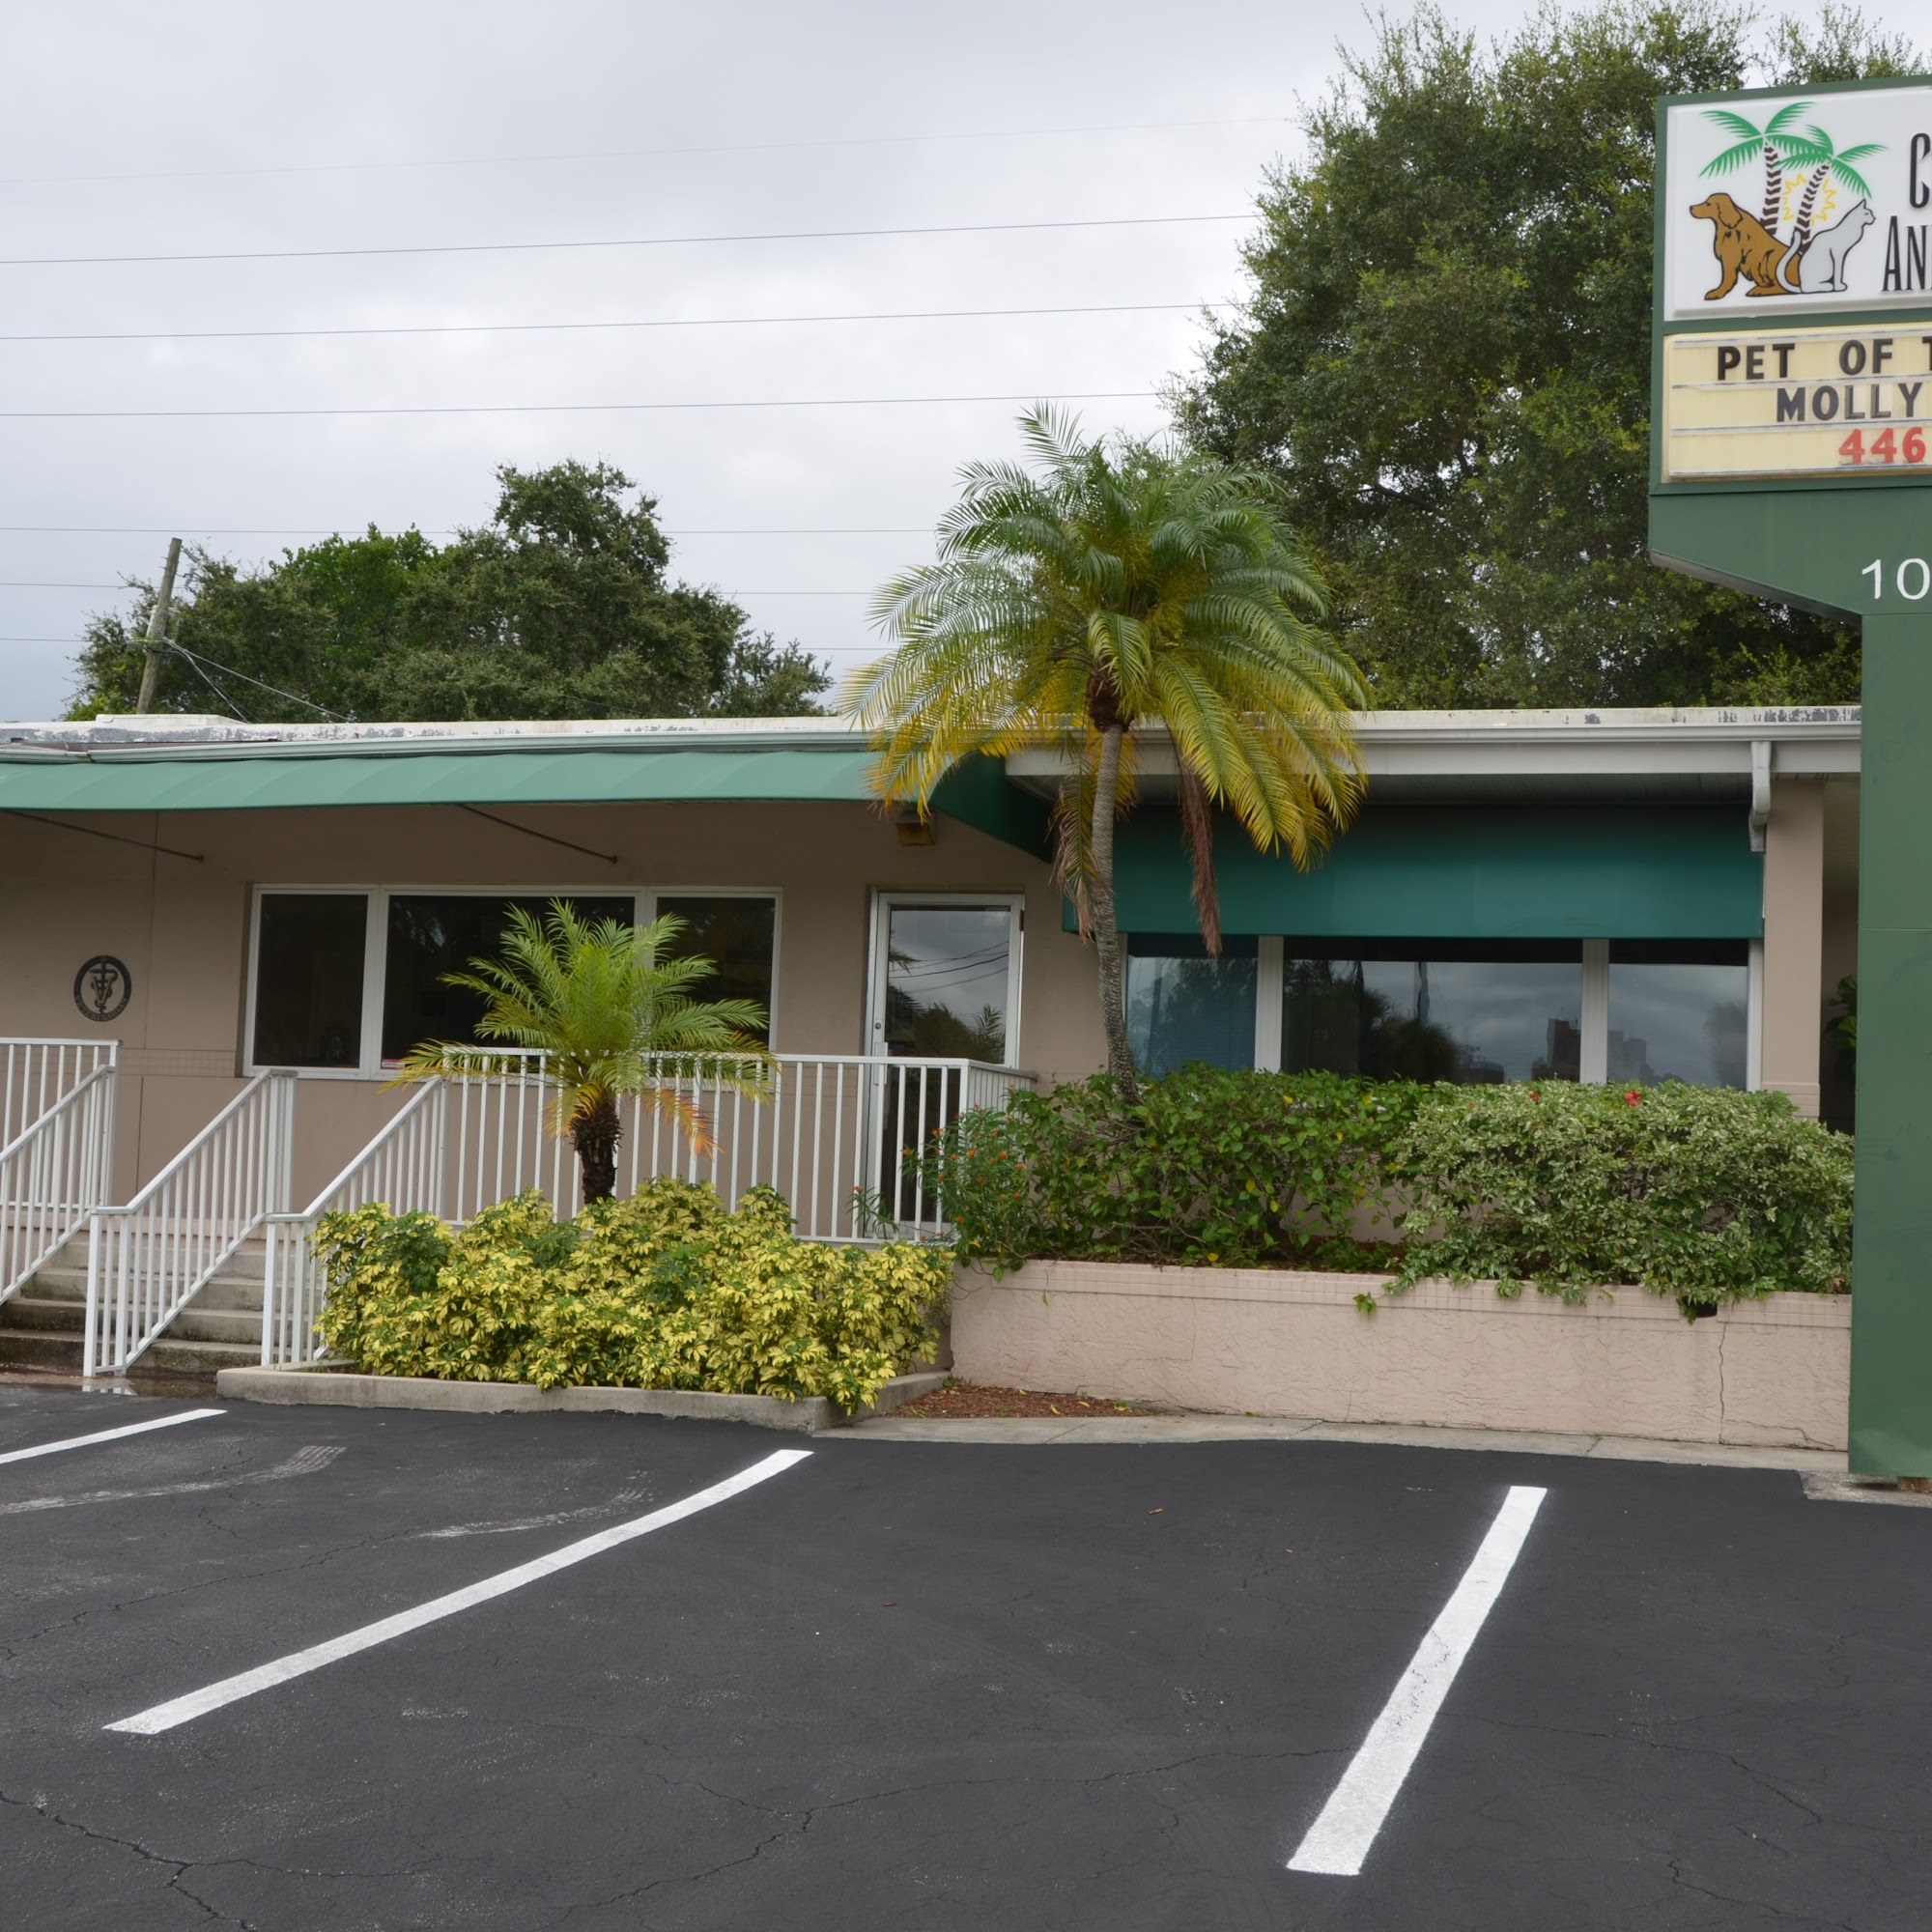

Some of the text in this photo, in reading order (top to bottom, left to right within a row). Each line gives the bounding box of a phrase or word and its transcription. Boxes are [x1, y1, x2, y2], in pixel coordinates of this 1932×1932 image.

[1882, 215, 1932, 292] AN
[1718, 343, 1795, 380] PET
[1839, 339, 1892, 375] OF
[1776, 383, 1922, 422] MOLLY
[1838, 427, 1926, 464] 446
[1862, 558, 1930, 600] 10
